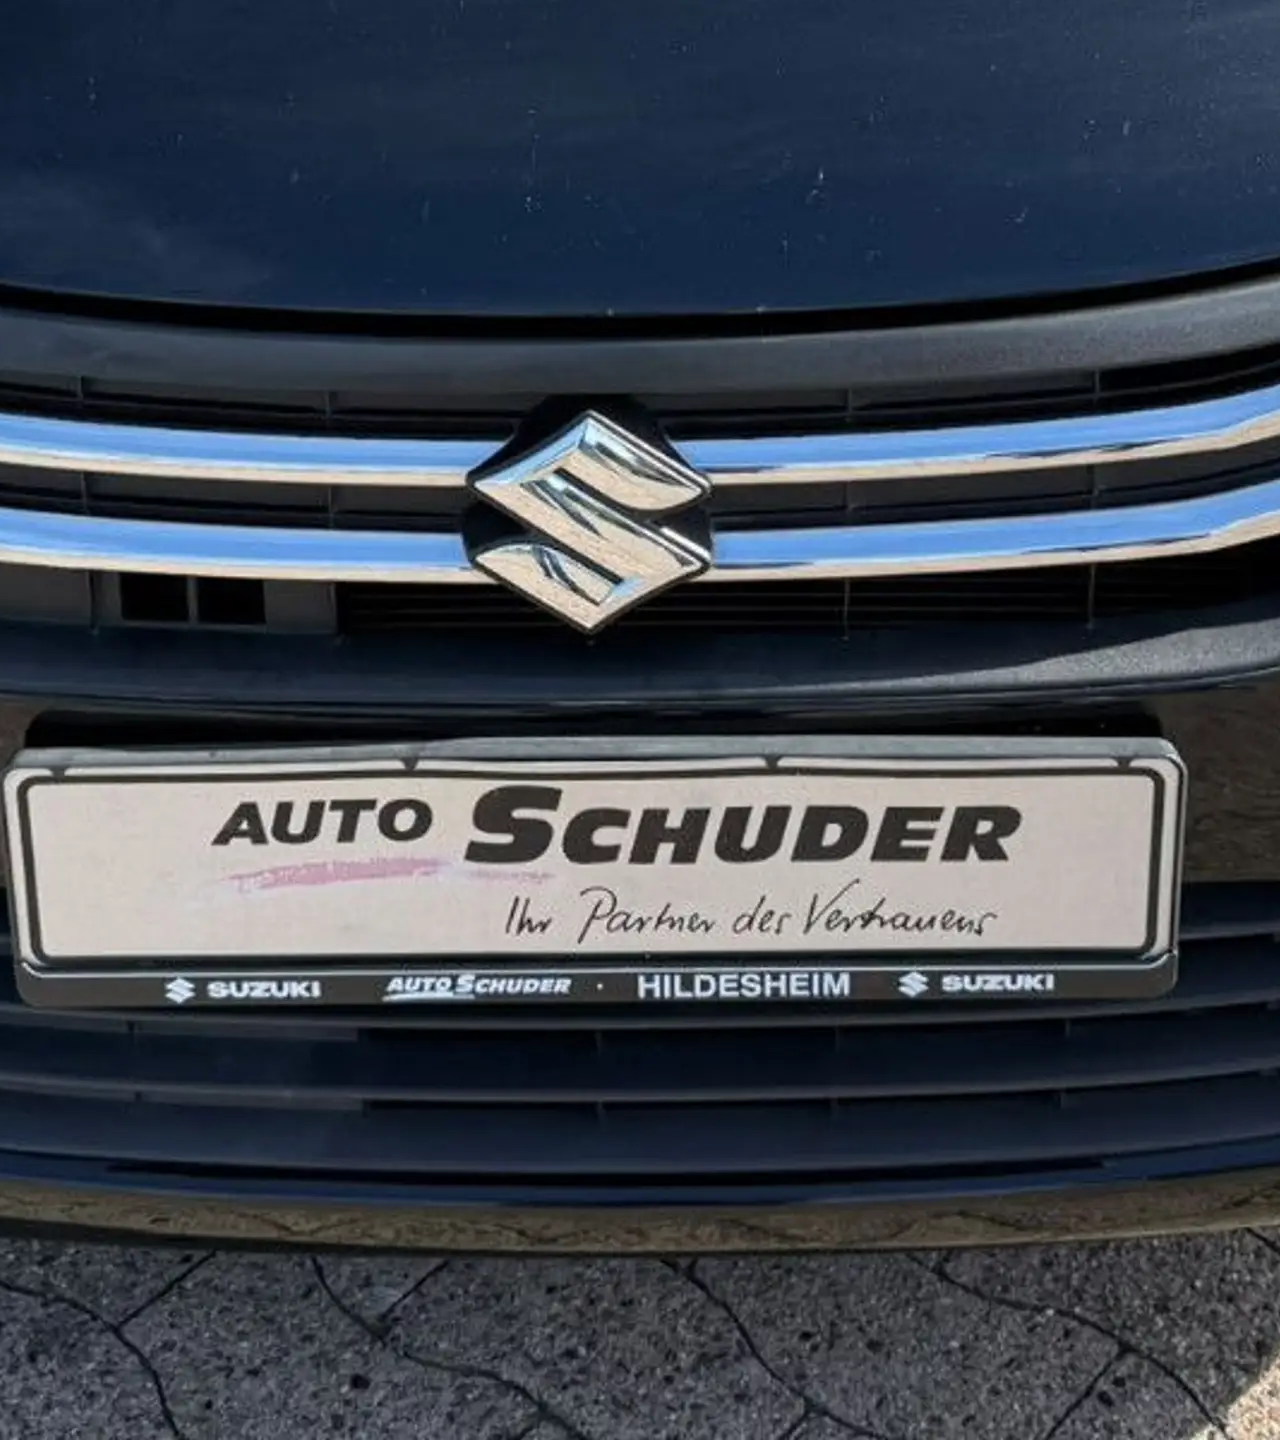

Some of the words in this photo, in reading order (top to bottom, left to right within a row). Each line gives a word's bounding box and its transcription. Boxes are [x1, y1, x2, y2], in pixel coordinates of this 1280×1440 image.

[211, 799, 433, 846] AUTO
[463, 785, 1022, 865] SCHUDER
[505, 895, 552, 936] Ihr
[577, 885, 718, 945] Partner
[731, 894, 792, 936] des
[801, 877, 999, 937] Vertrauens
[207, 981, 321, 998] SUZUKI
[637, 972, 852, 999] HILDESHEIM
[941, 973, 1055, 993] SUZUKI
